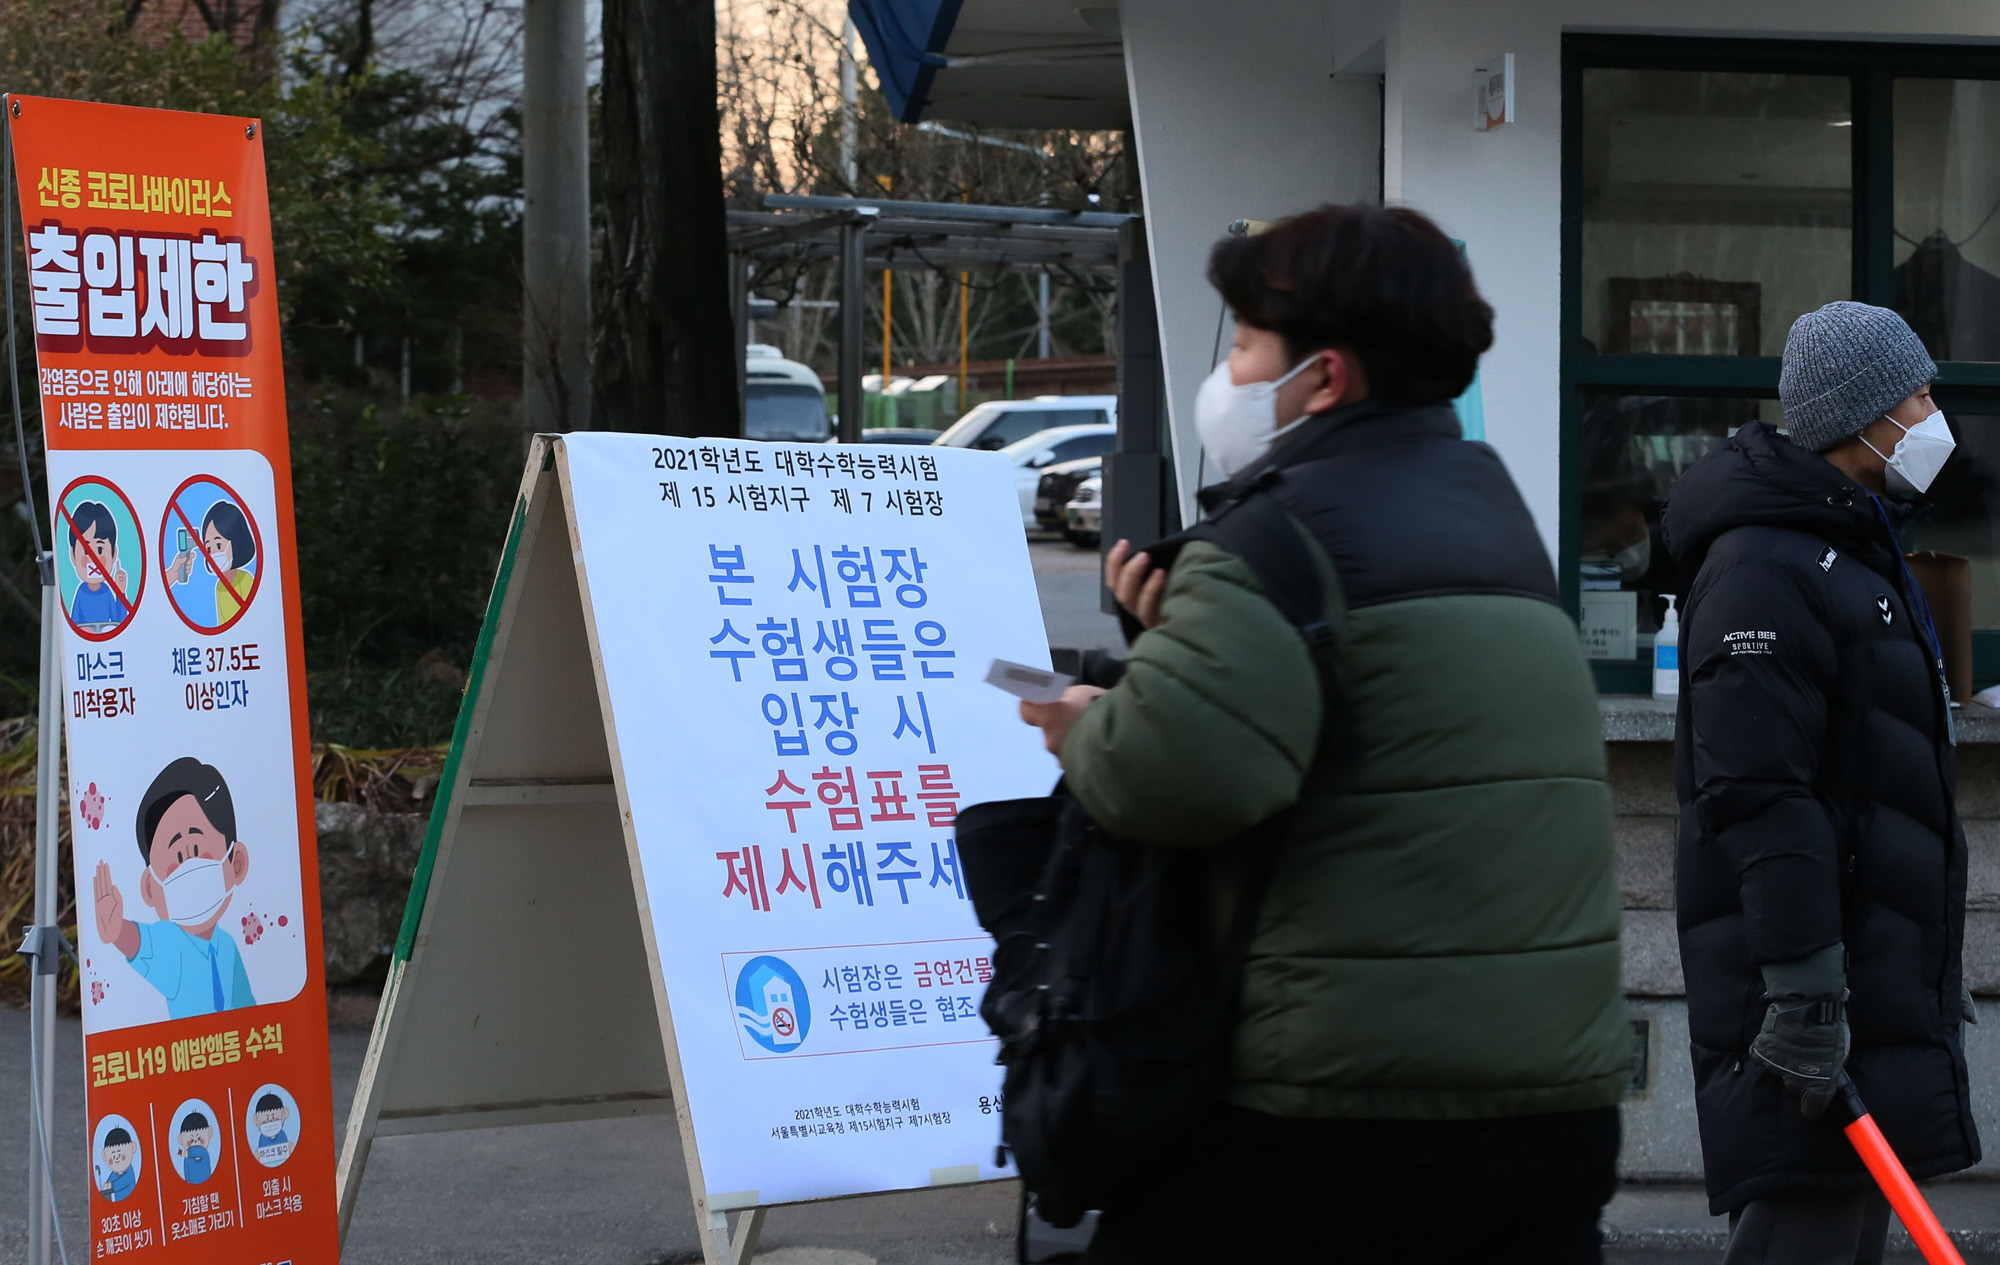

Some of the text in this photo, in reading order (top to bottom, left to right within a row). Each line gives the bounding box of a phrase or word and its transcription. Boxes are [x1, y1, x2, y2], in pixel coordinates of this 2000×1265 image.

[38, 167, 232, 217] 신종 코로나바이러스
[29, 225, 254, 341] 출입제한
[41, 368, 252, 398] 감염증으로 인해 아래에 해당하는
[59, 402, 229, 430] 사람은 출입이 제한됩니다.
[652, 446, 939, 482] 2021학년도 대학수학능력시험
[659, 481, 943, 517] 제 15 시험지구 제 7 시험장
[707, 543, 928, 609] 본 시험장
[709, 616, 956, 683] 수험생들은
[1723, 631, 1776, 642] ACTIVE BEE
[1732, 642, 1769, 650] SPORTIVE
[77, 651, 125, 681] 마스크
[172, 644, 261, 676] 체온 37.5도
[73, 687, 136, 719] 미착용자
[185, 680, 249, 710] 이상인자
[761, 691, 936, 757] 입장 시
[765, 764, 961, 834] 수험표를
[716, 838, 973, 912] 제시해주세
[822, 957, 993, 994] 시험장은 금연건물
[829, 996, 977, 1031] 수험생들은 협조
[92, 1023, 283, 1087] 코로나19 예방행동 수칙
[794, 1098, 920, 1121] 2021학년도 대학수학능력시험
[771, 1111, 951, 1141] 서울특별시교육청 제15시험지구 제7시험장
[260, 1145, 288, 1158] 마스크 필수
[262, 1176, 292, 1197] 외출 시
[182, 1195, 209, 1216] 기침할
[256, 1195, 303, 1220] 마스크 착용
[101, 1209, 142, 1234] 30초 이상
[171, 1210, 235, 1241] 옷소매로 가리기
[96, 1228, 153, 1259] 손 깨끗이 씻기
